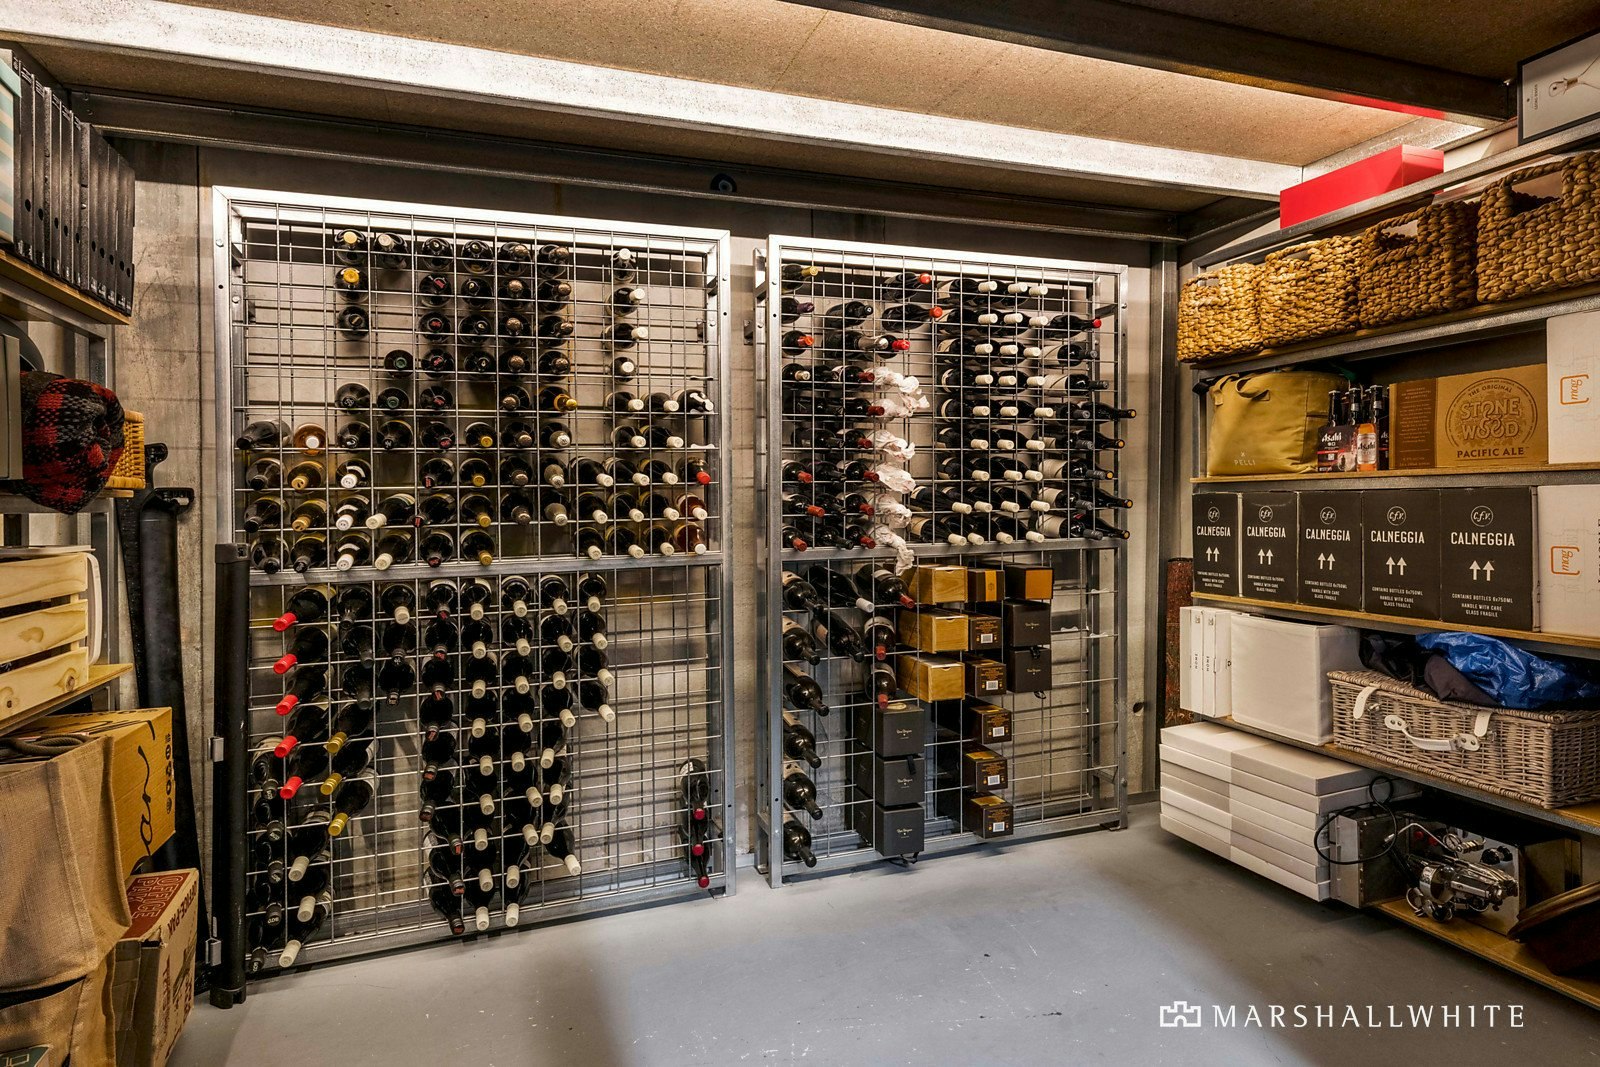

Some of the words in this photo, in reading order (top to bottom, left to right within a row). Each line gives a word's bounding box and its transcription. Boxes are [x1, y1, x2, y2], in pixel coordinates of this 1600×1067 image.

[1468, 388, 1480, 397] THE
[1482, 384, 1512, 393] ORIGINAL
[1461, 396, 1521, 420] STONE
[1461, 420, 1520, 441] WOOD
[1321, 431, 1342, 443] Asahi
[1357, 441, 1376, 450] Asahi
[1457, 448, 1500, 458] PACIFIC
[1503, 447, 1525, 456] ALE
[1196, 525, 1231, 537] CALNEGGIA
[1246, 526, 1286, 538] CALNEGGIA
[1305, 528, 1351, 541] CALNEGGIA
[1370, 530, 1425, 544] CALNEGGIA
[1450, 532, 1516, 546] CALNEGGIA
[1473, 594, 1492, 602] BOTTLES
[1480, 610, 1499, 618] FRAGILE
